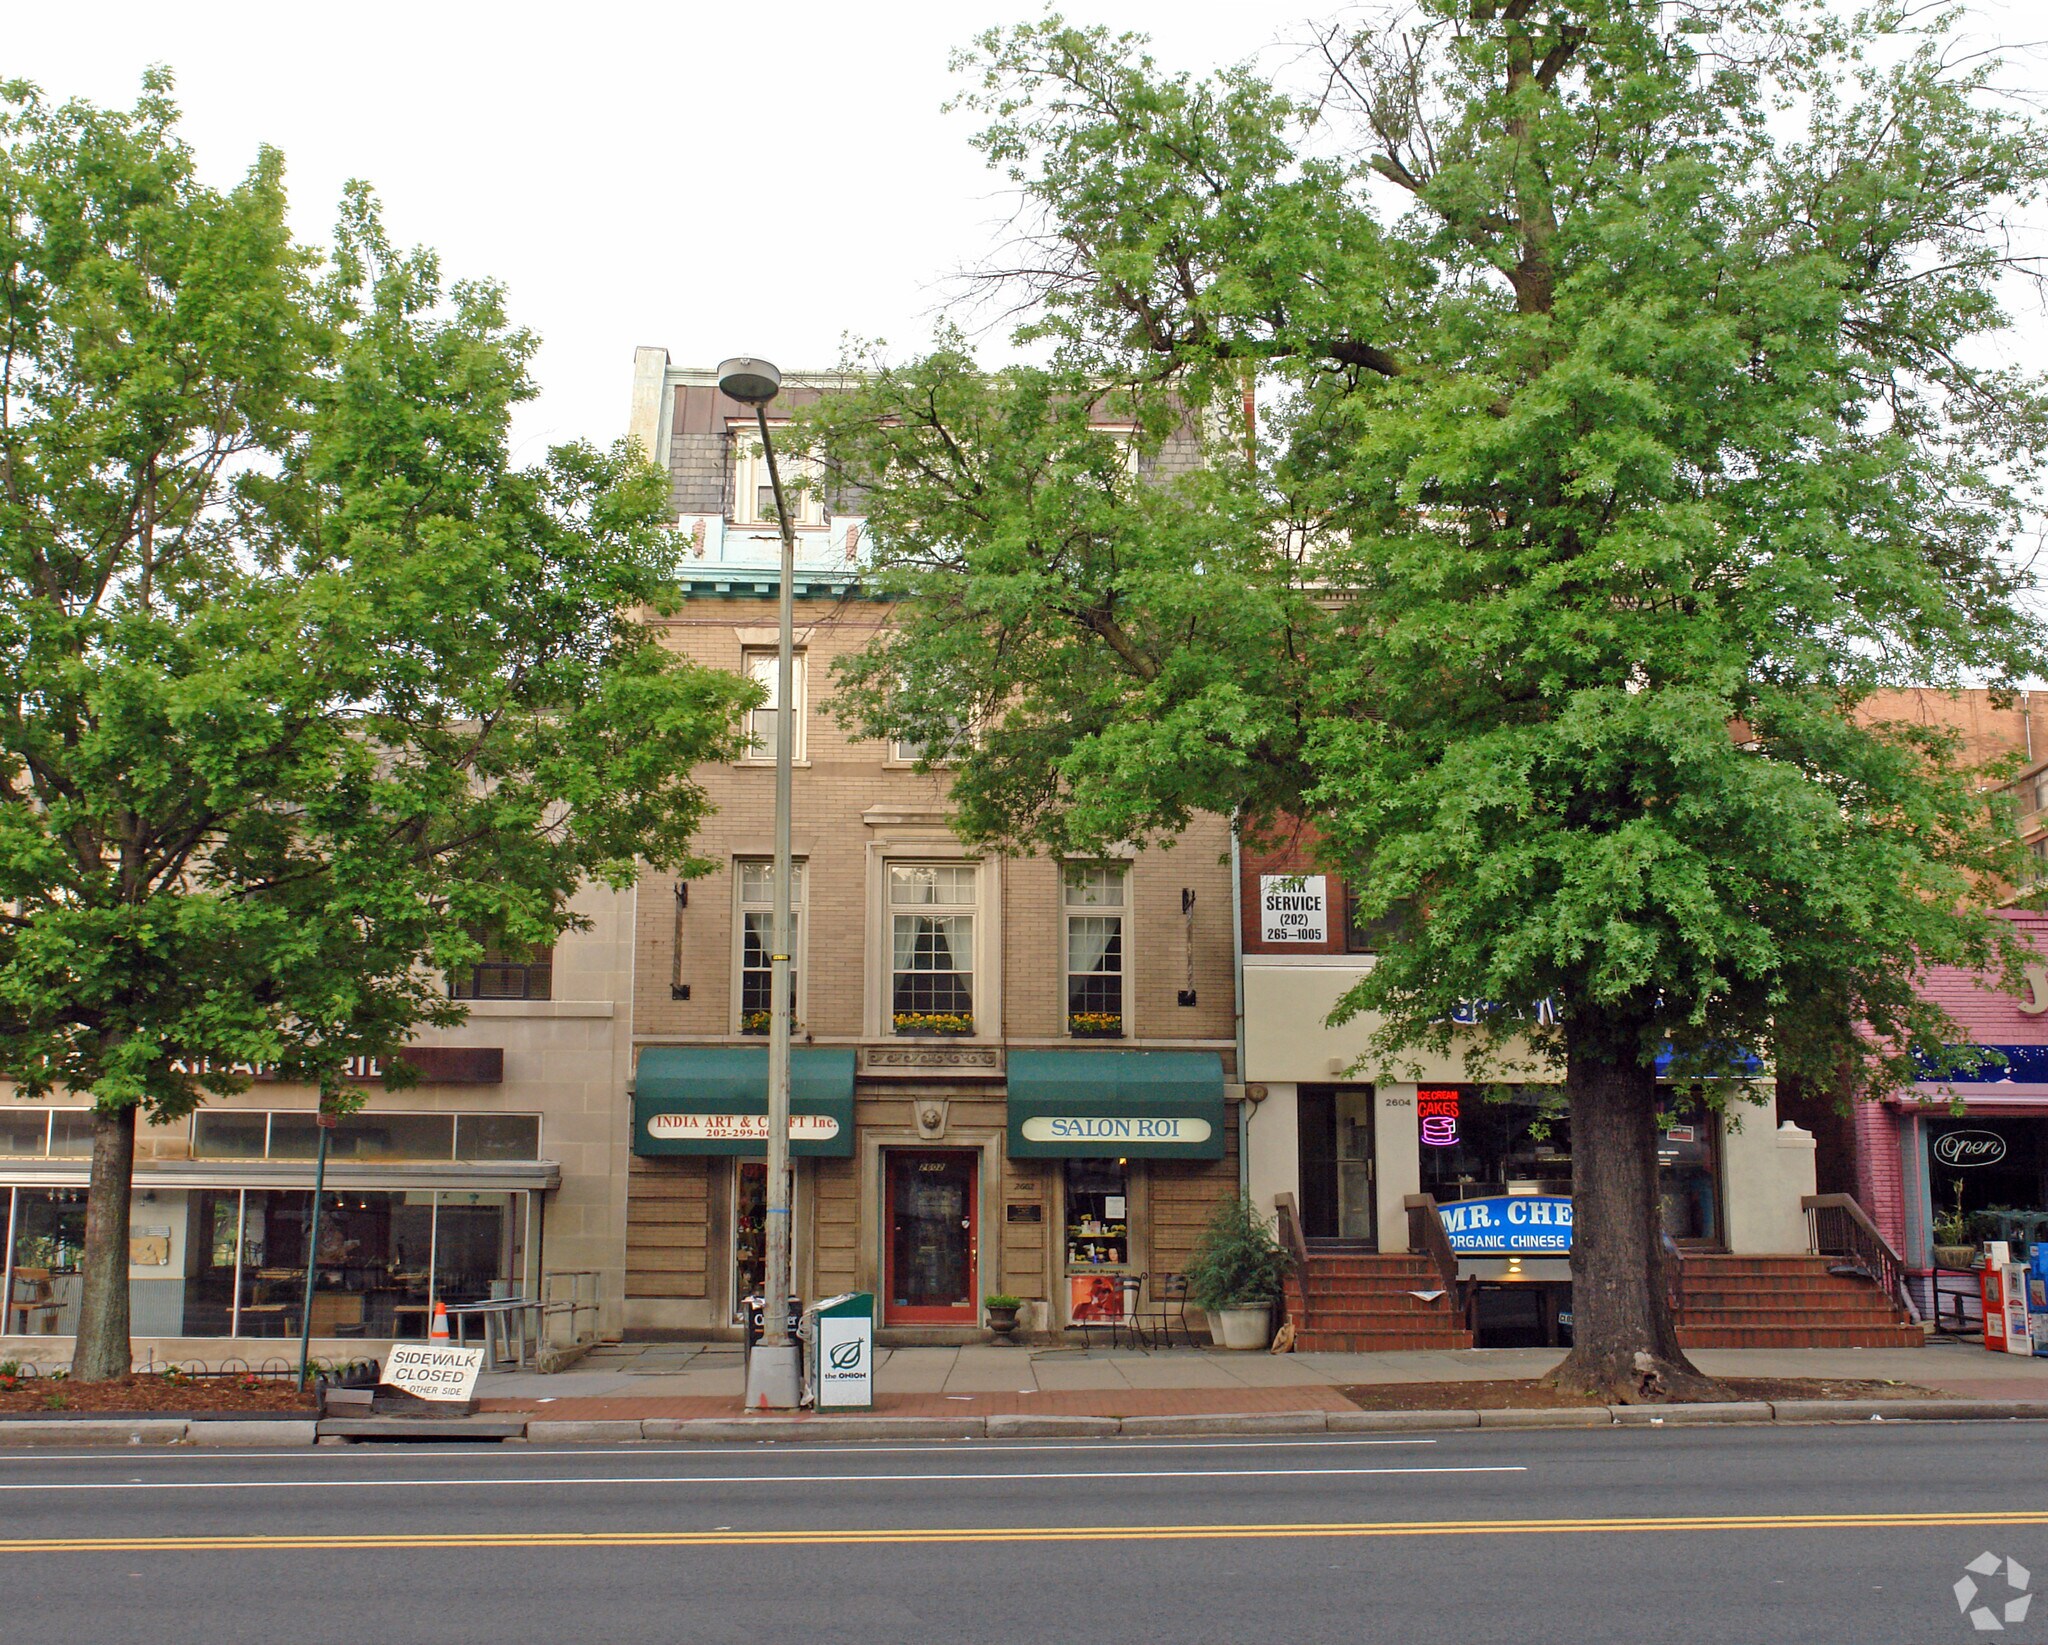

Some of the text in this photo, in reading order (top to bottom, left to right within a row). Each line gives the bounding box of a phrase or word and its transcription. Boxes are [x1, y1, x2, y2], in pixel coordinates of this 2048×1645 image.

[1266, 896, 1321, 911] SERVICE
[1280, 913, 1308, 927] (202)
[1418, 1091, 1458, 1100] ICE CREAM
[1418, 1102, 1459, 1117] CAKES
[657, 1116, 837, 1128] INDIA ART & CFT Inc.
[1051, 1119, 1180, 1137] SALON ROI
[1941, 1137, 2001, 1162] Open
[1439, 1201, 1573, 1234] MR. CHE
[1449, 1235, 1506, 1248] ORGANIC
[1510, 1235, 1565, 1247] CHINESE
[394, 1351, 477, 1367] SIDEWALK
[396, 1368, 465, 1383] CLOSED
[409, 1385, 438, 1394] OTHER
[442, 1387, 463, 1396] SIDE
